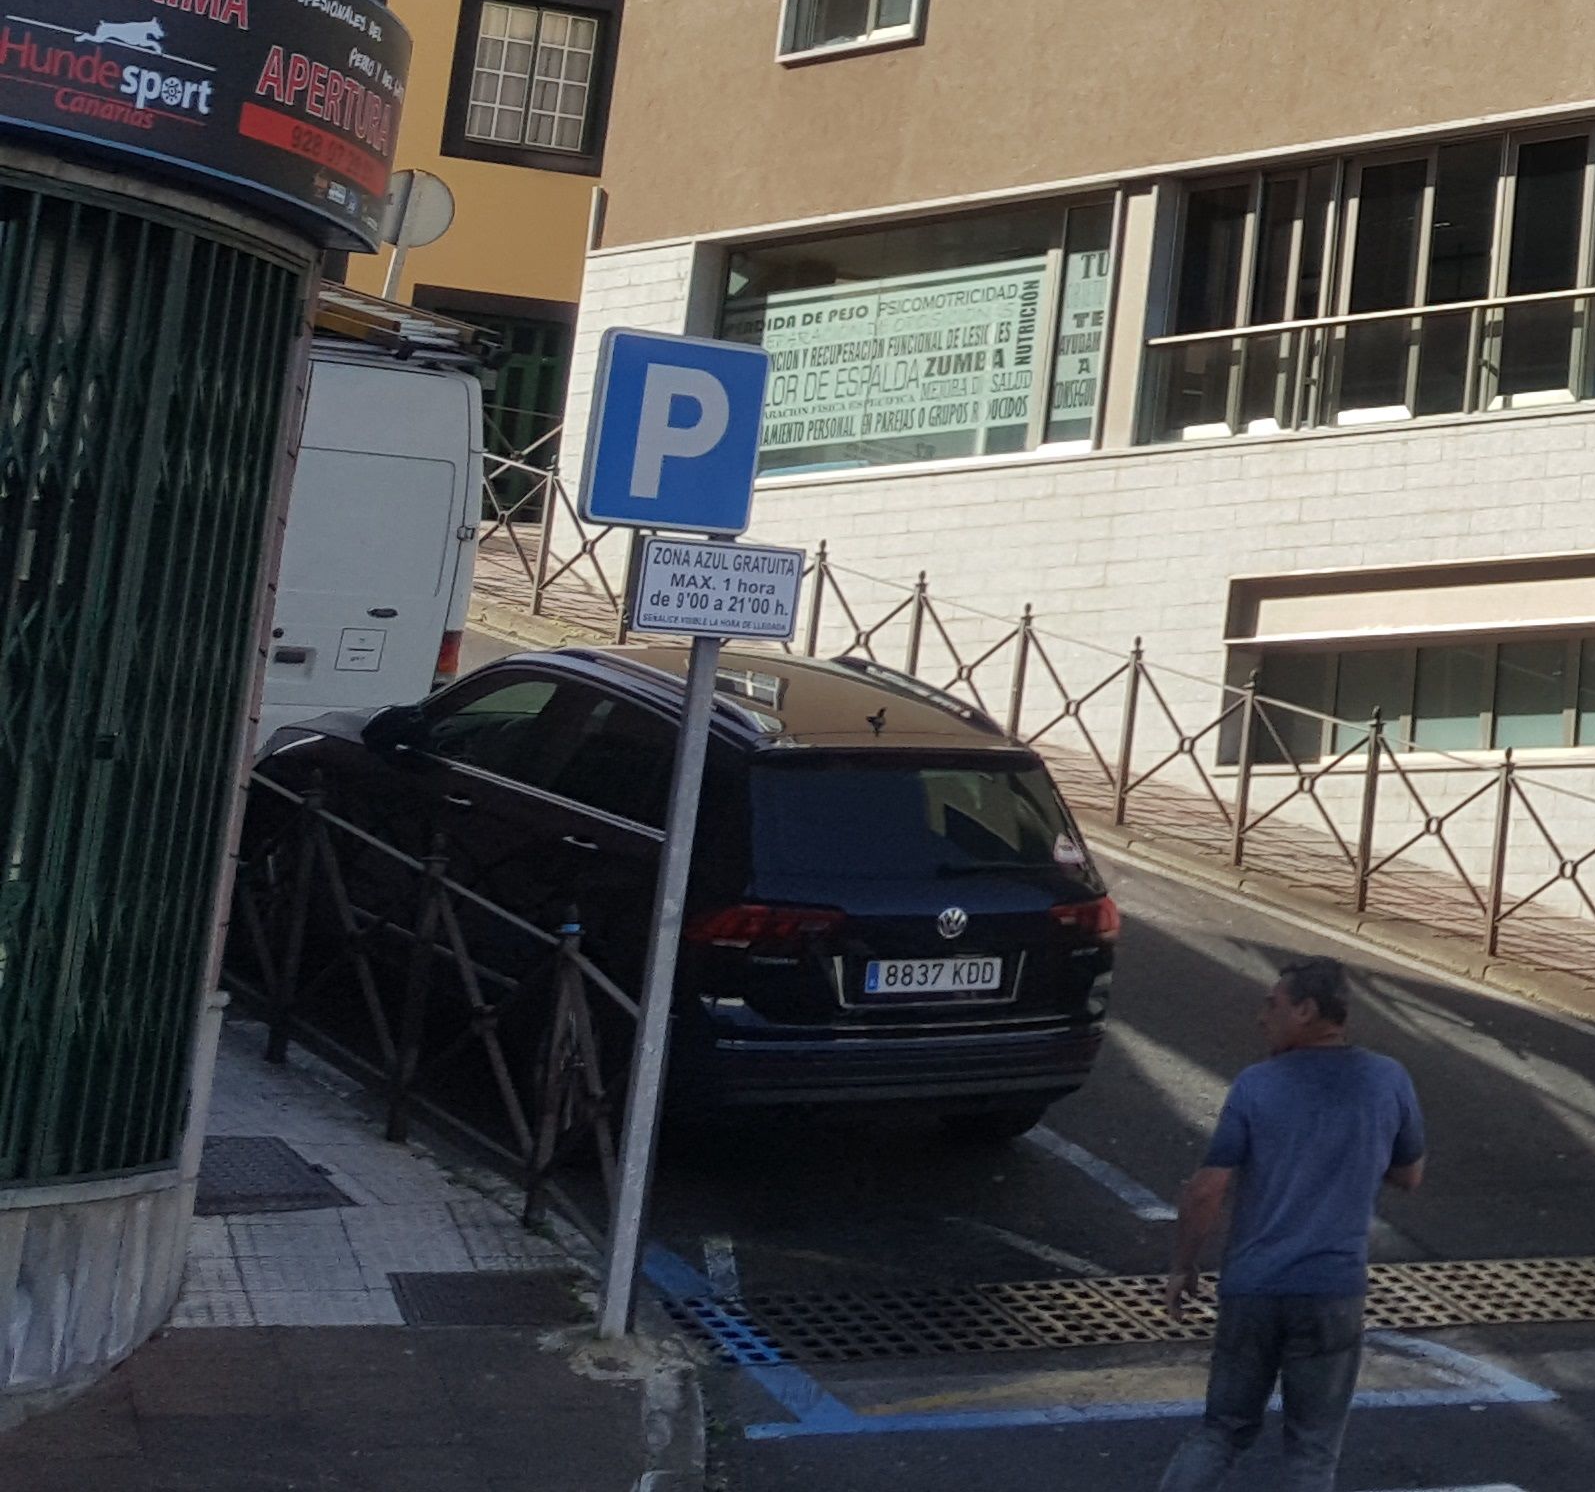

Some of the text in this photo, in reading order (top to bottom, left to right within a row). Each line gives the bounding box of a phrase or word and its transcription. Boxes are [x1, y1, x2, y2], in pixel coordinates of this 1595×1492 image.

[53, 85, 157, 130] Canarias
[255, 44, 392, 157] APERTURA
[801, 311, 823, 326] DE
[828, 305, 869, 322] PESO
[878, 283, 1018, 318] PSICOMOTRICIDAD
[1014, 279, 1041, 367] NUTRICIÓN
[887, 330, 943, 357] FUNCIONAL
[946, 327, 960, 349] DE
[803, 370, 830, 403] DE
[834, 358, 920, 399] ESPALDA
[989, 370, 1033, 394] SALUD
[630, 362, 730, 500] P
[762, 421, 805, 446] AMIENTO
[874, 406, 915, 434] PAREJAS
[928, 401, 969, 427] GRUPOS
[653, 547, 795, 576] ZONA AZUL GRATUITA
[670, 573, 776, 595] MAX. 1 hora
[650, 590, 670, 607] de
[714, 599, 723, 611] a
[774, 598, 789, 617] h.
[884, 961, 995, 988] 8837 KDD
